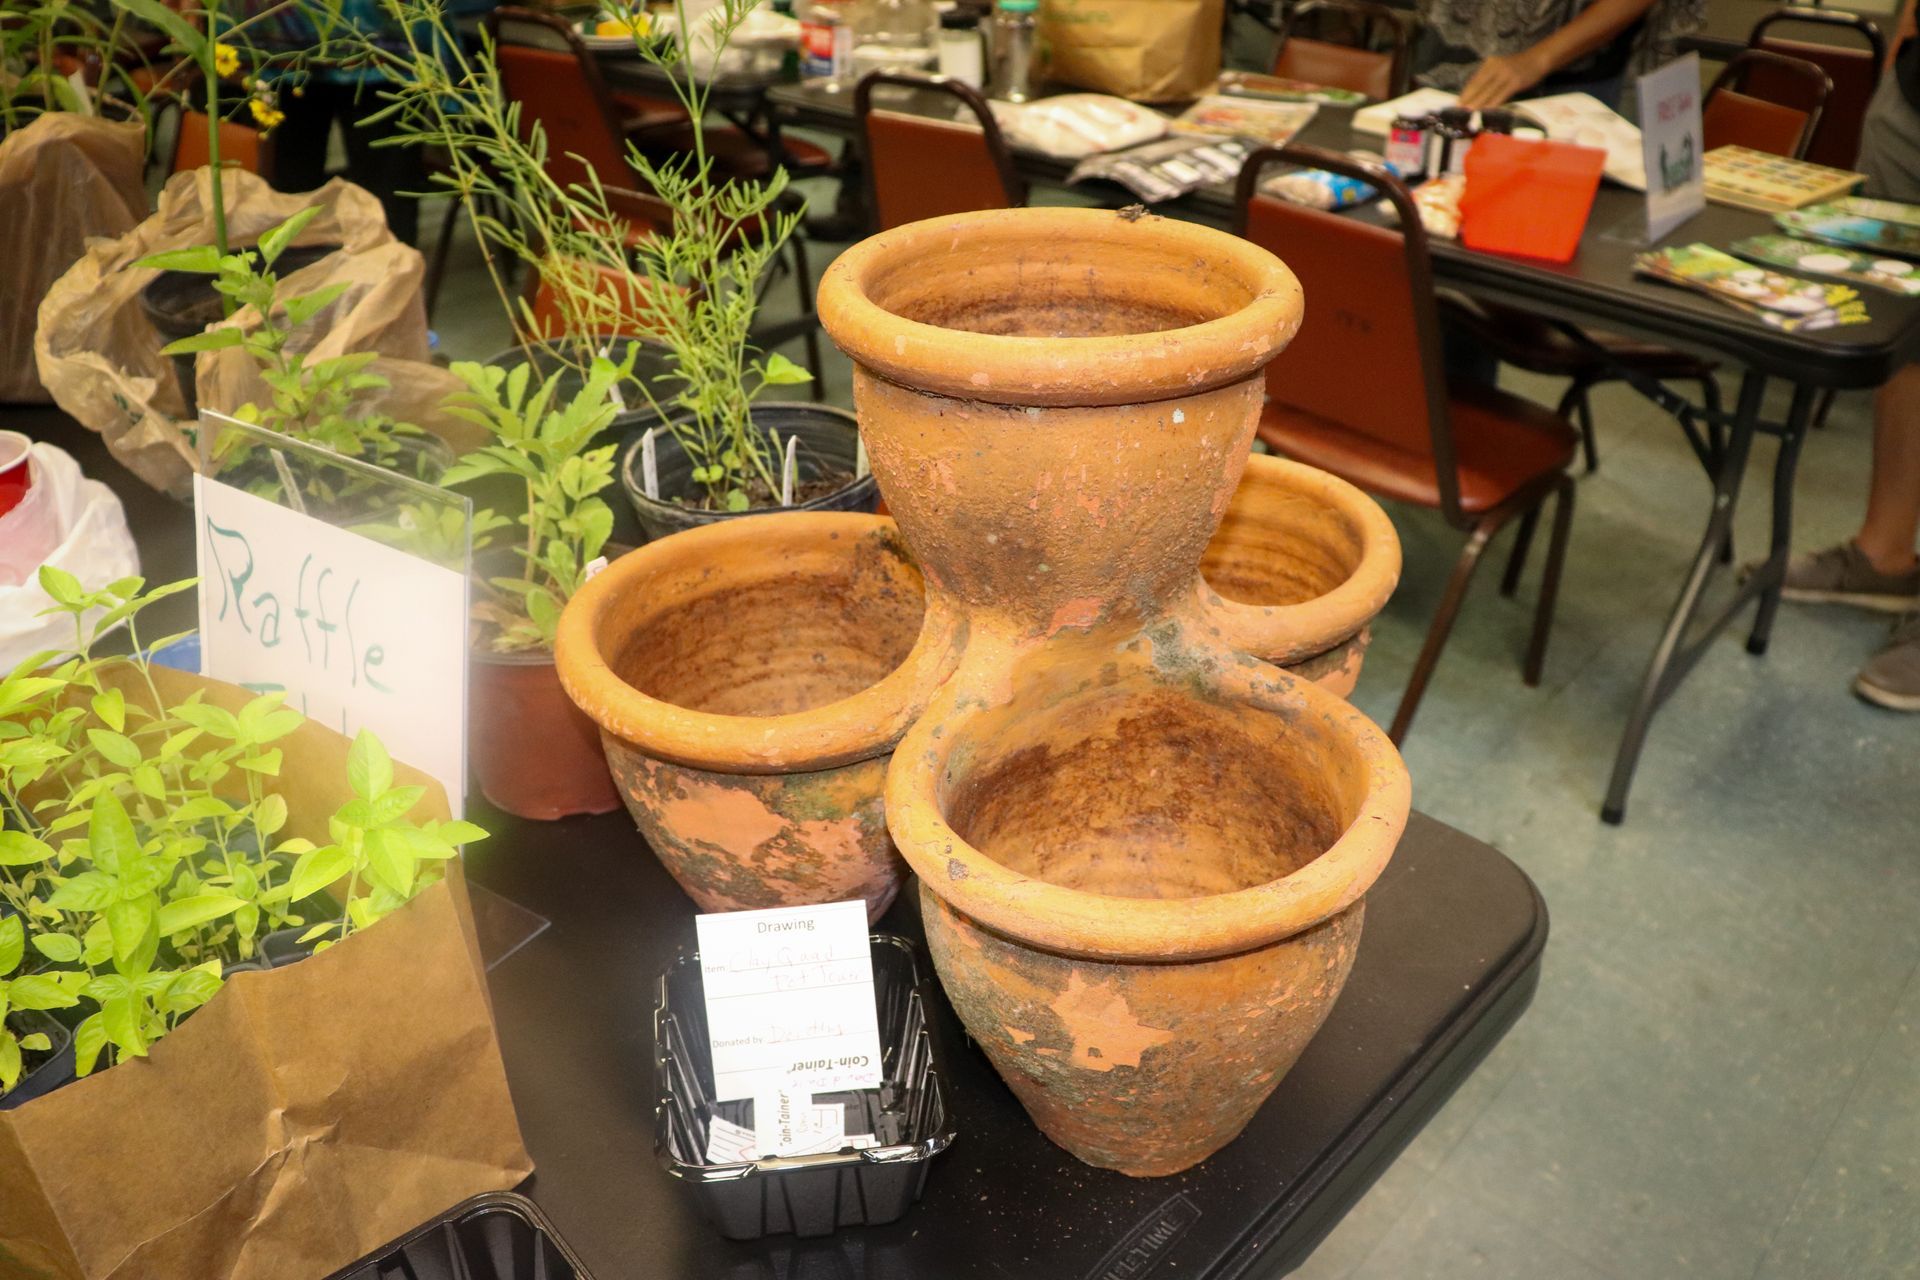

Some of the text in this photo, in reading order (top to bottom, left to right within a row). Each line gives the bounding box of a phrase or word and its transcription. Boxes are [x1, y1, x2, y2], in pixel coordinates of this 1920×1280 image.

[207, 515, 395, 694] Raffle
[757, 919, 815, 935] Drawing
[704, 966, 726, 974] Item
[712, 1037, 764, 1048] Donated by
